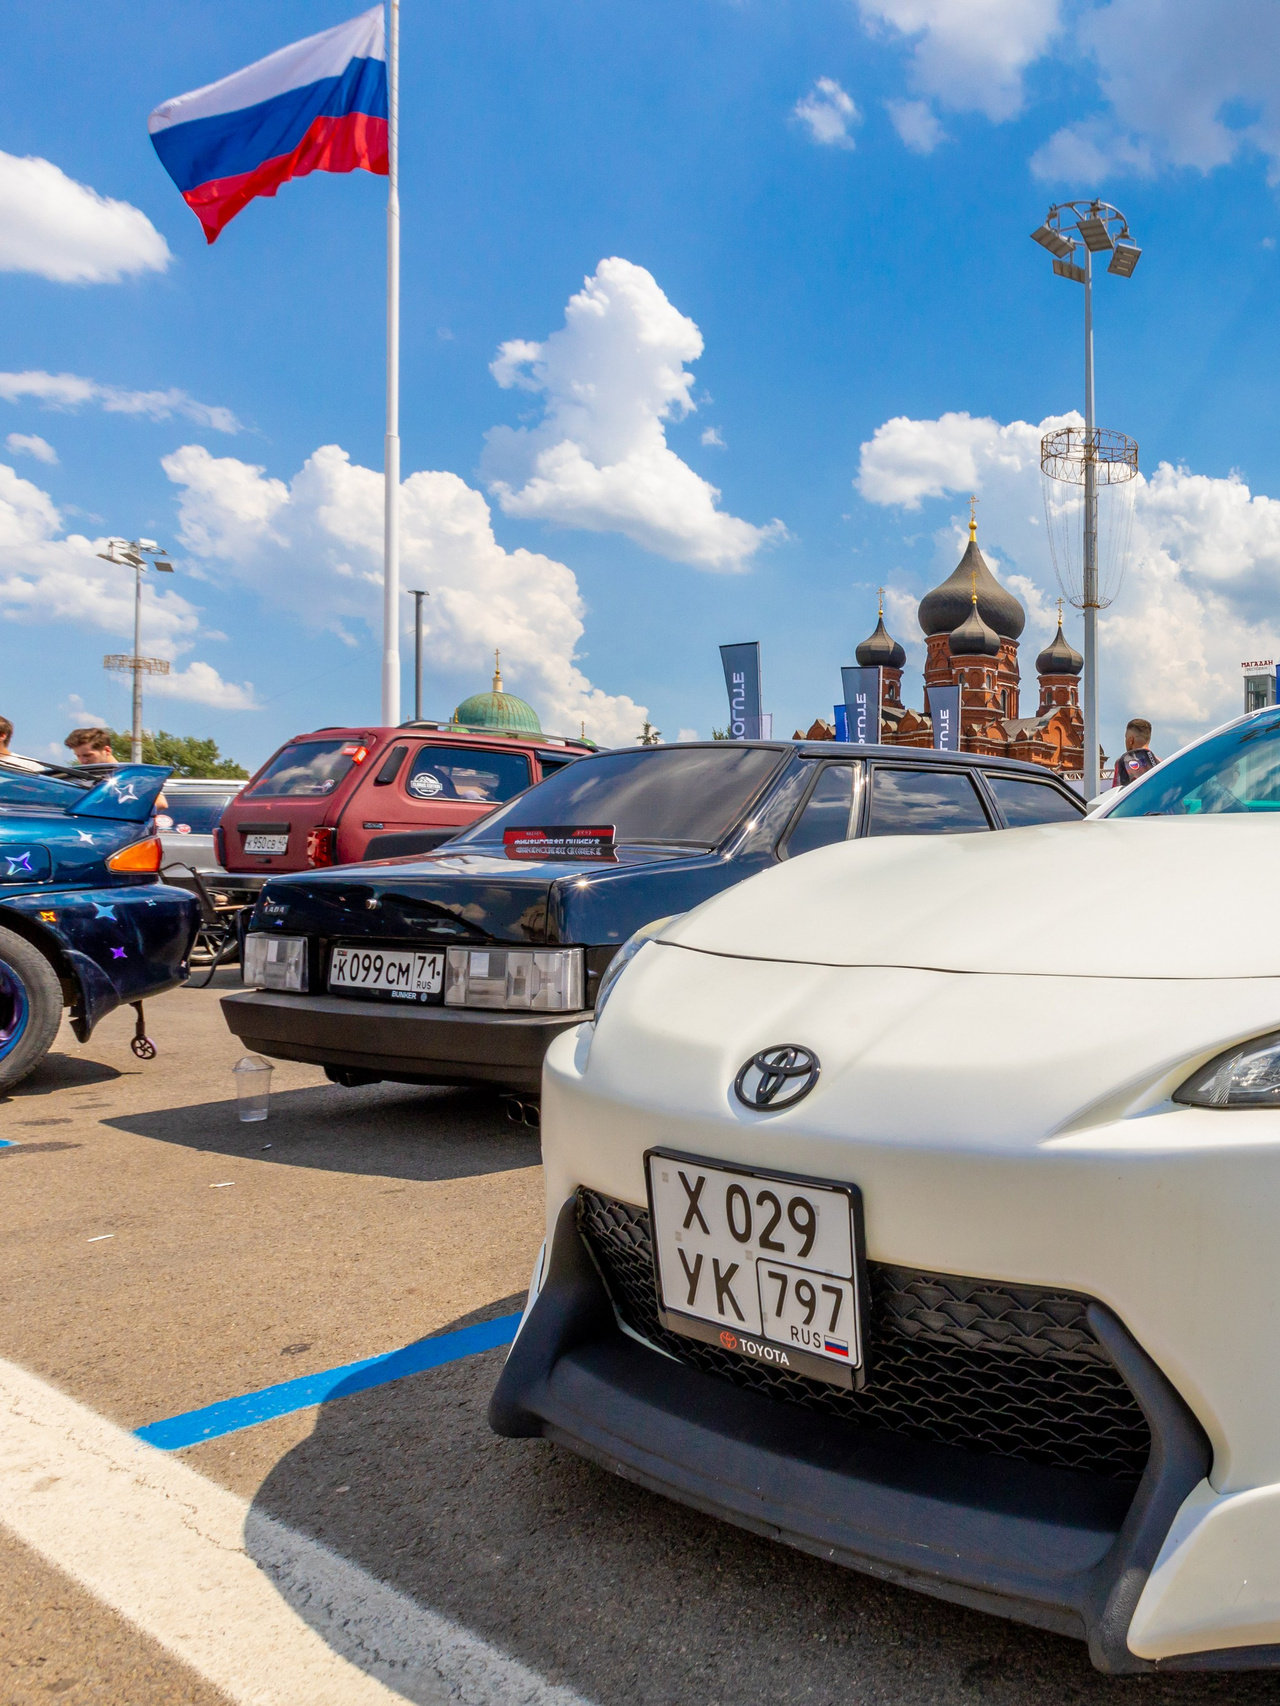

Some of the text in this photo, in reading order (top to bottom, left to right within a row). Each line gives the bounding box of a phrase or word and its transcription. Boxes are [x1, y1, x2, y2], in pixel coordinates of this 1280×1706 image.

[1241, 660, 1273, 668] МАГАДАН
[391, 990, 417, 1000] BUNKER
[416, 981, 432, 990] RUS
[726, 1184, 816, 1258] 029
[768, 1270, 843, 1333] 797
[790, 1325, 821, 1349] RUS
[739, 1338, 790, 1366] TOYOTA
